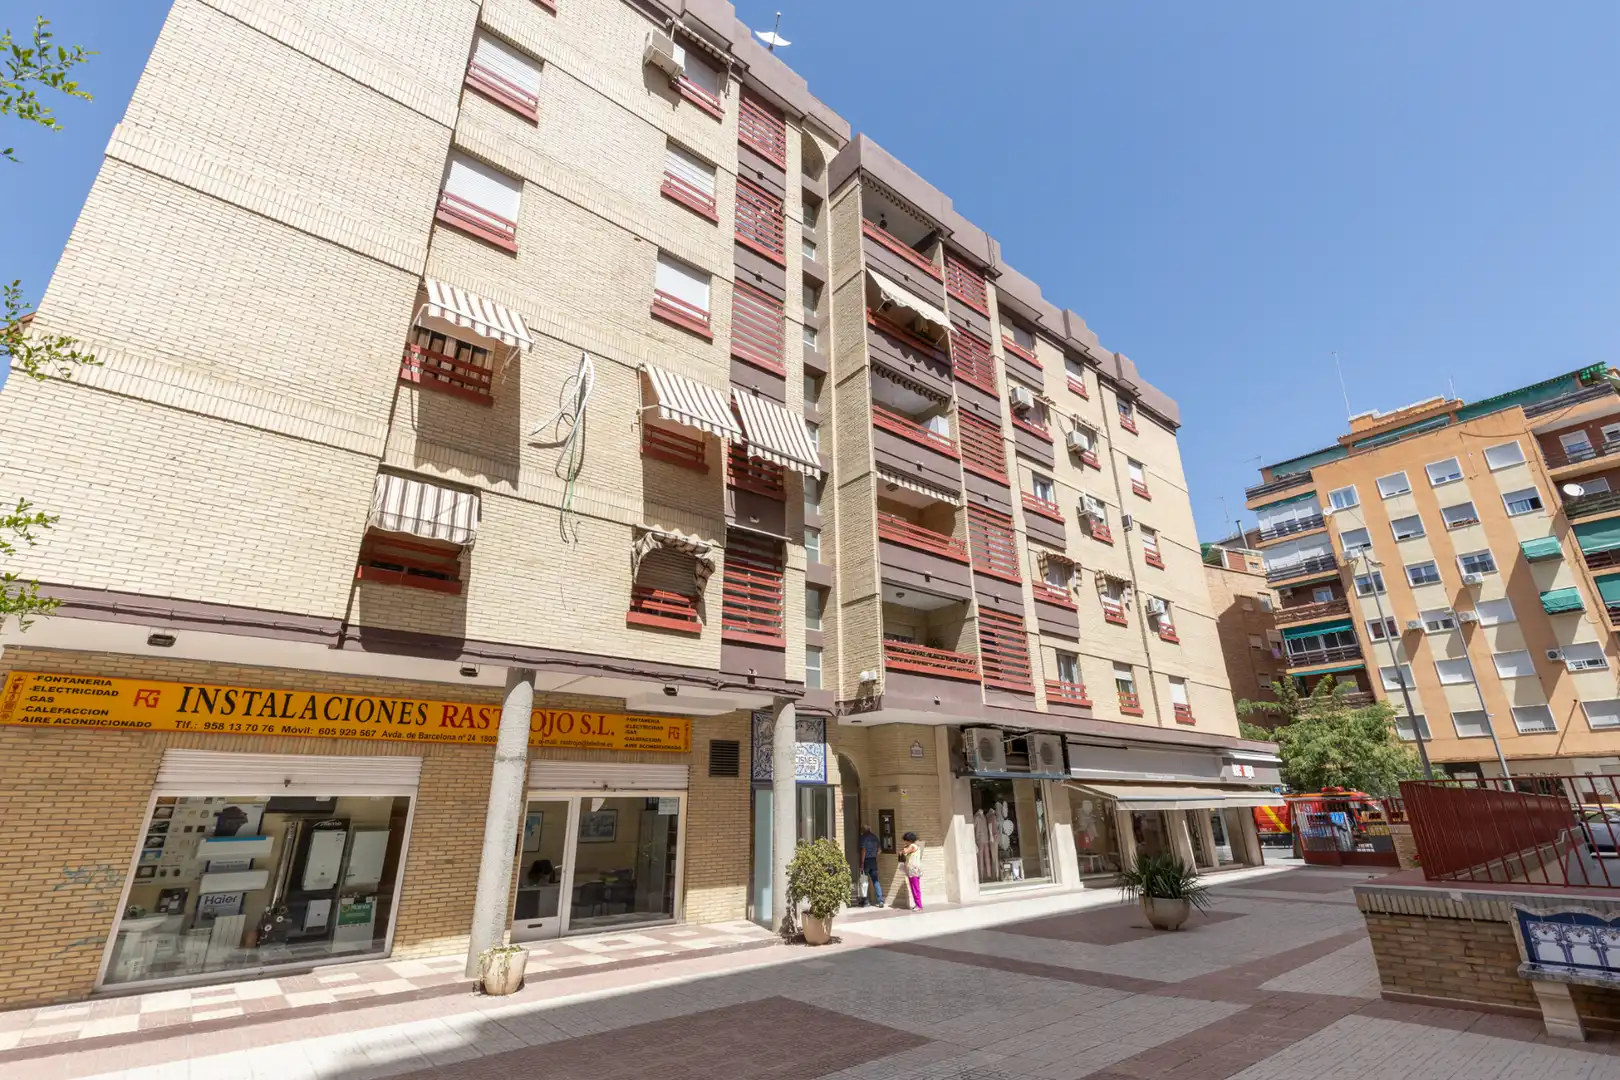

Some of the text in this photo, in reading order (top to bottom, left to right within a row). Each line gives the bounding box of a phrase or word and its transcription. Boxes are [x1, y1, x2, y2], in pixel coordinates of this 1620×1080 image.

[176, 686, 615, 737] INSTALACIONES RASTOJO S.L.
[54, 717, 152, 728] ACONDICIONADO
[204, 721, 225, 731] 958
[228, 723, 242, 732] 13
[245, 723, 258, 732] 70
[261, 724, 275, 733] 76
[318, 727, 337, 736] 605
[339, 728, 357, 737] 929
[359, 729, 377, 737] 567
[381, 730, 405, 739] Avda.
[406, 731, 416, 740] de
[418, 732, 456, 741] Barcelona
[467, 734, 476, 742] 24
[204, 894, 238, 905] Haier
